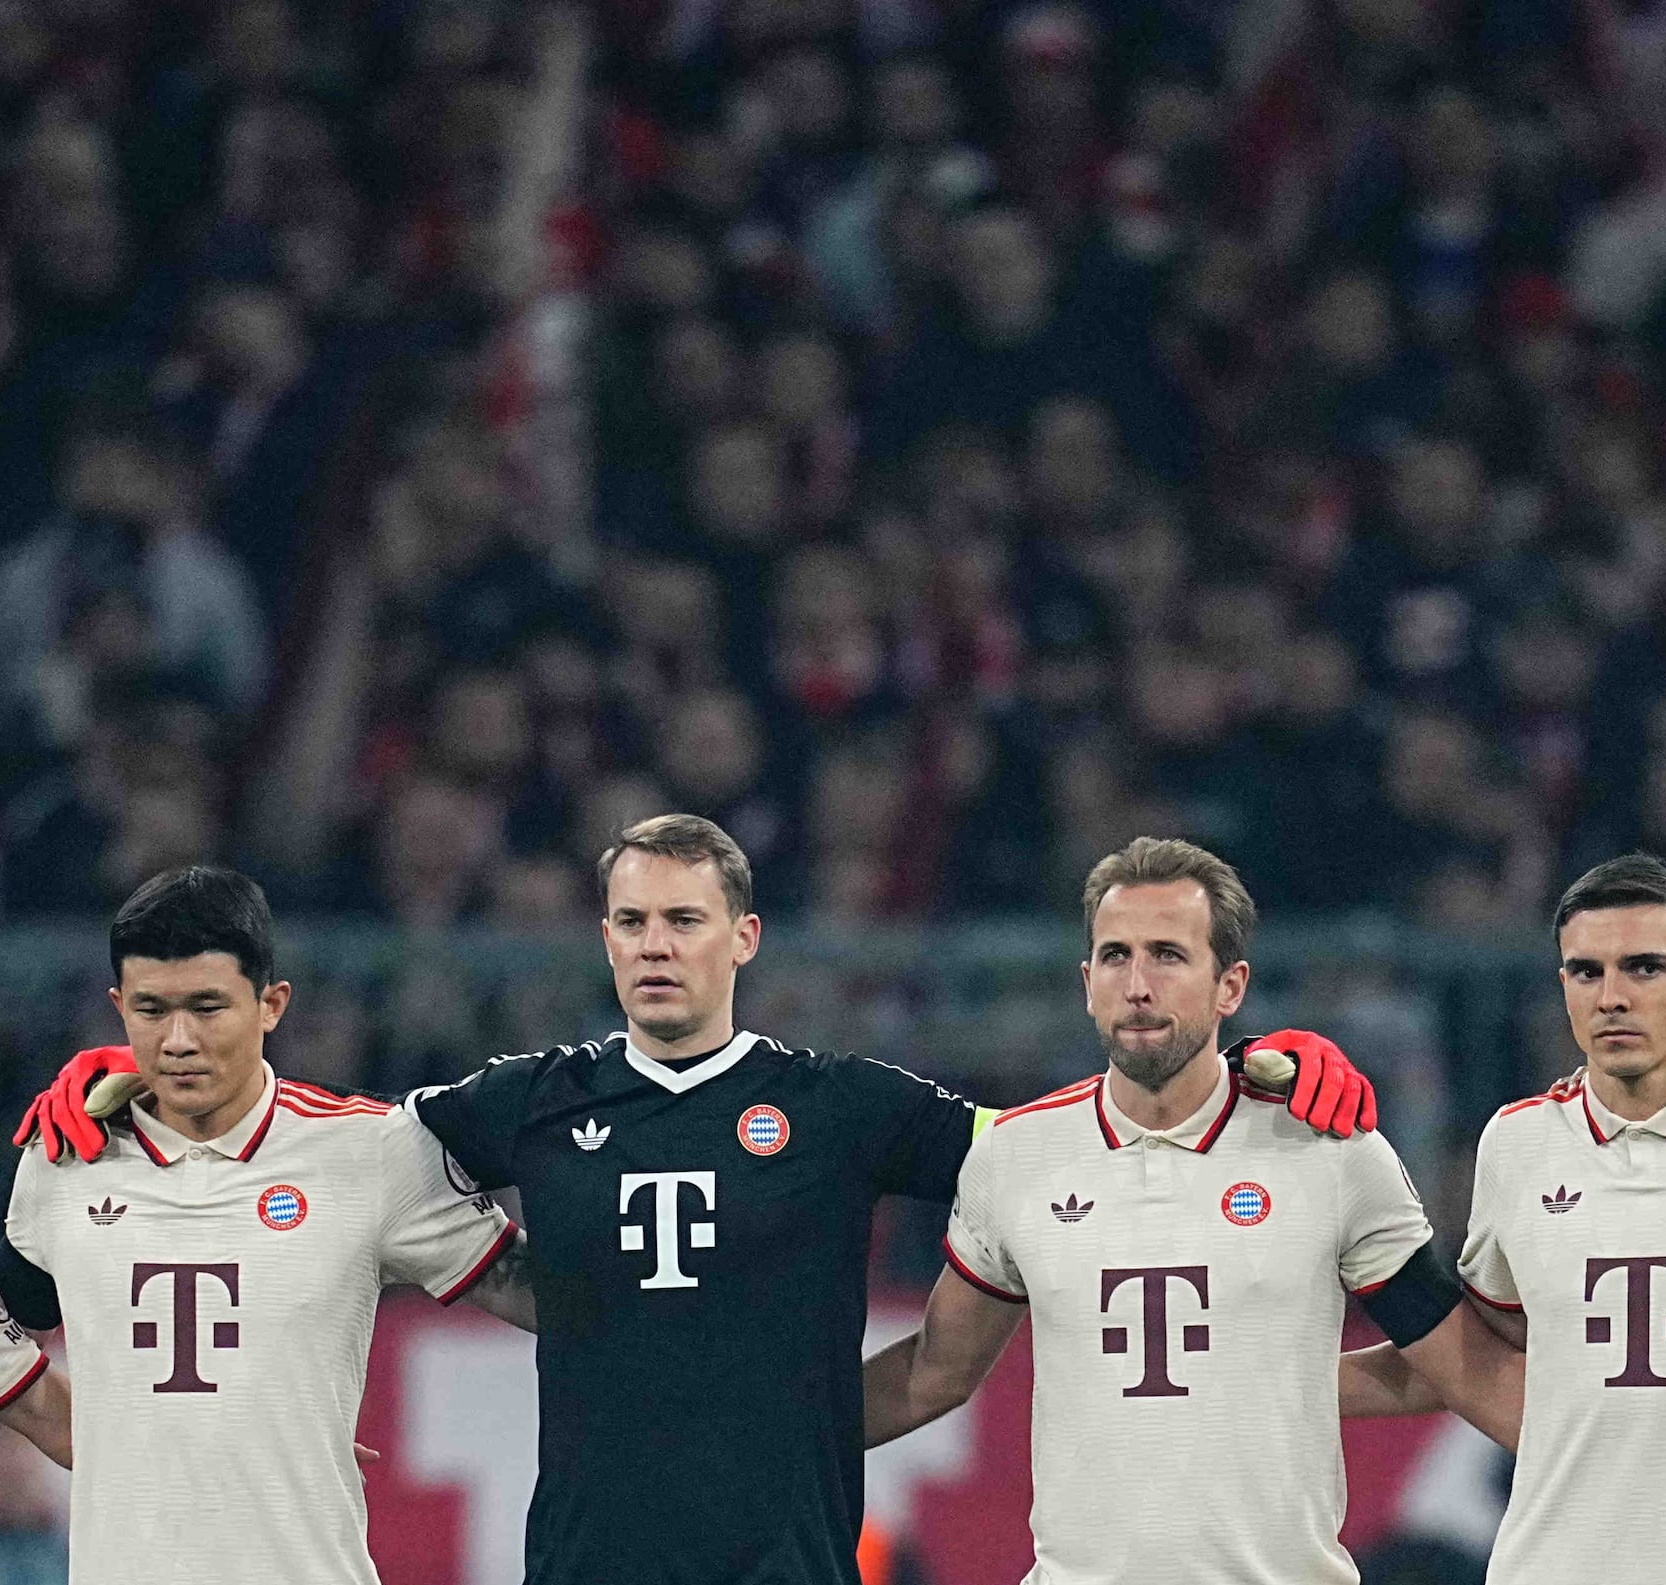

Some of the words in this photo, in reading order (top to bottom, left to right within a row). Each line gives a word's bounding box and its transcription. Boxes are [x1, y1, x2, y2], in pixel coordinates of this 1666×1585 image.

[619, 1171, 715, 1289] T
[132, 1263, 239, 1392] T
[1101, 1266, 1209, 1397] T
